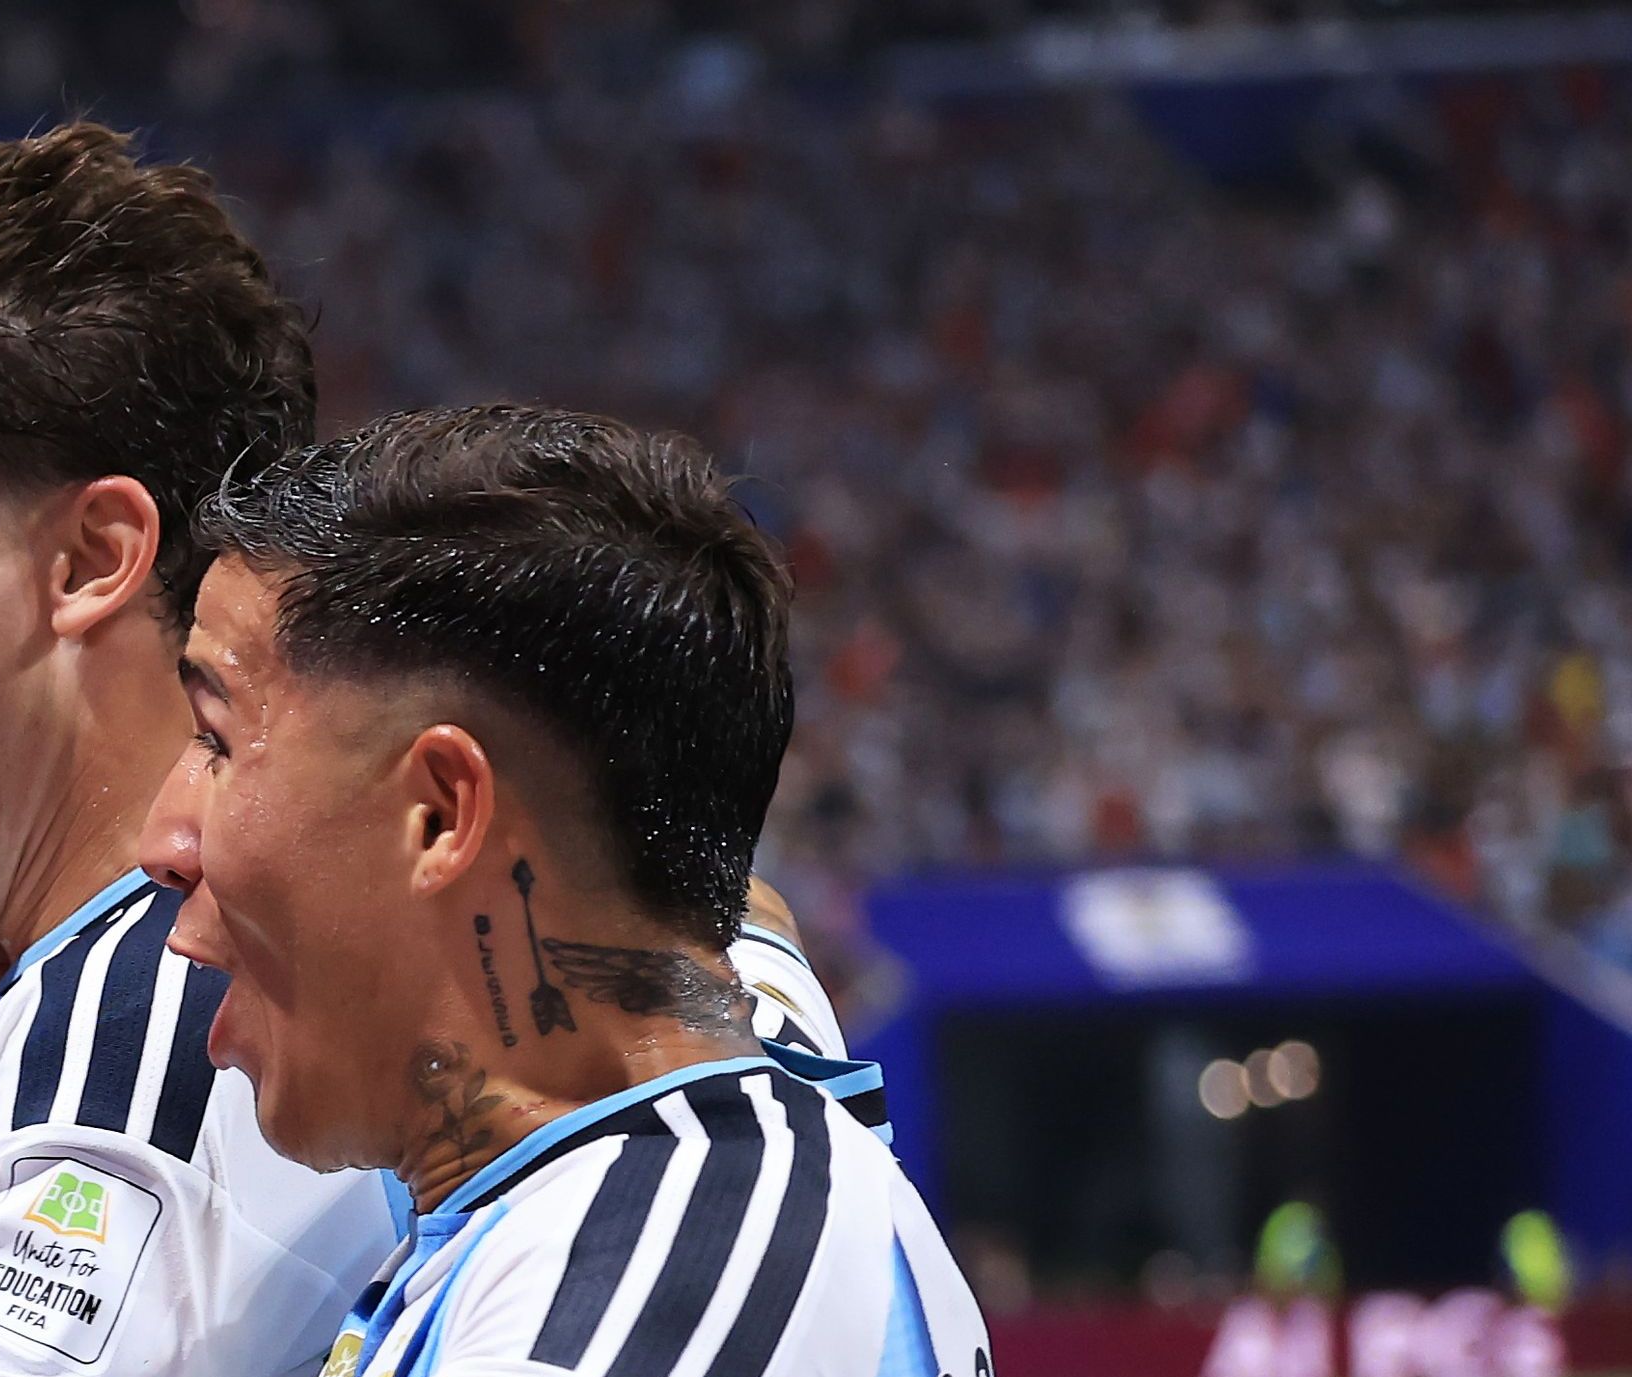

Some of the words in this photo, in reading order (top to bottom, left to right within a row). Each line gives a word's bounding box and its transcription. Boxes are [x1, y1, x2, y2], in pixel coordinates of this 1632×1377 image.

[13, 1230, 65, 1268] Unite
[67, 1248, 100, 1277] For
[6, 1304, 46, 1329] FIFA
